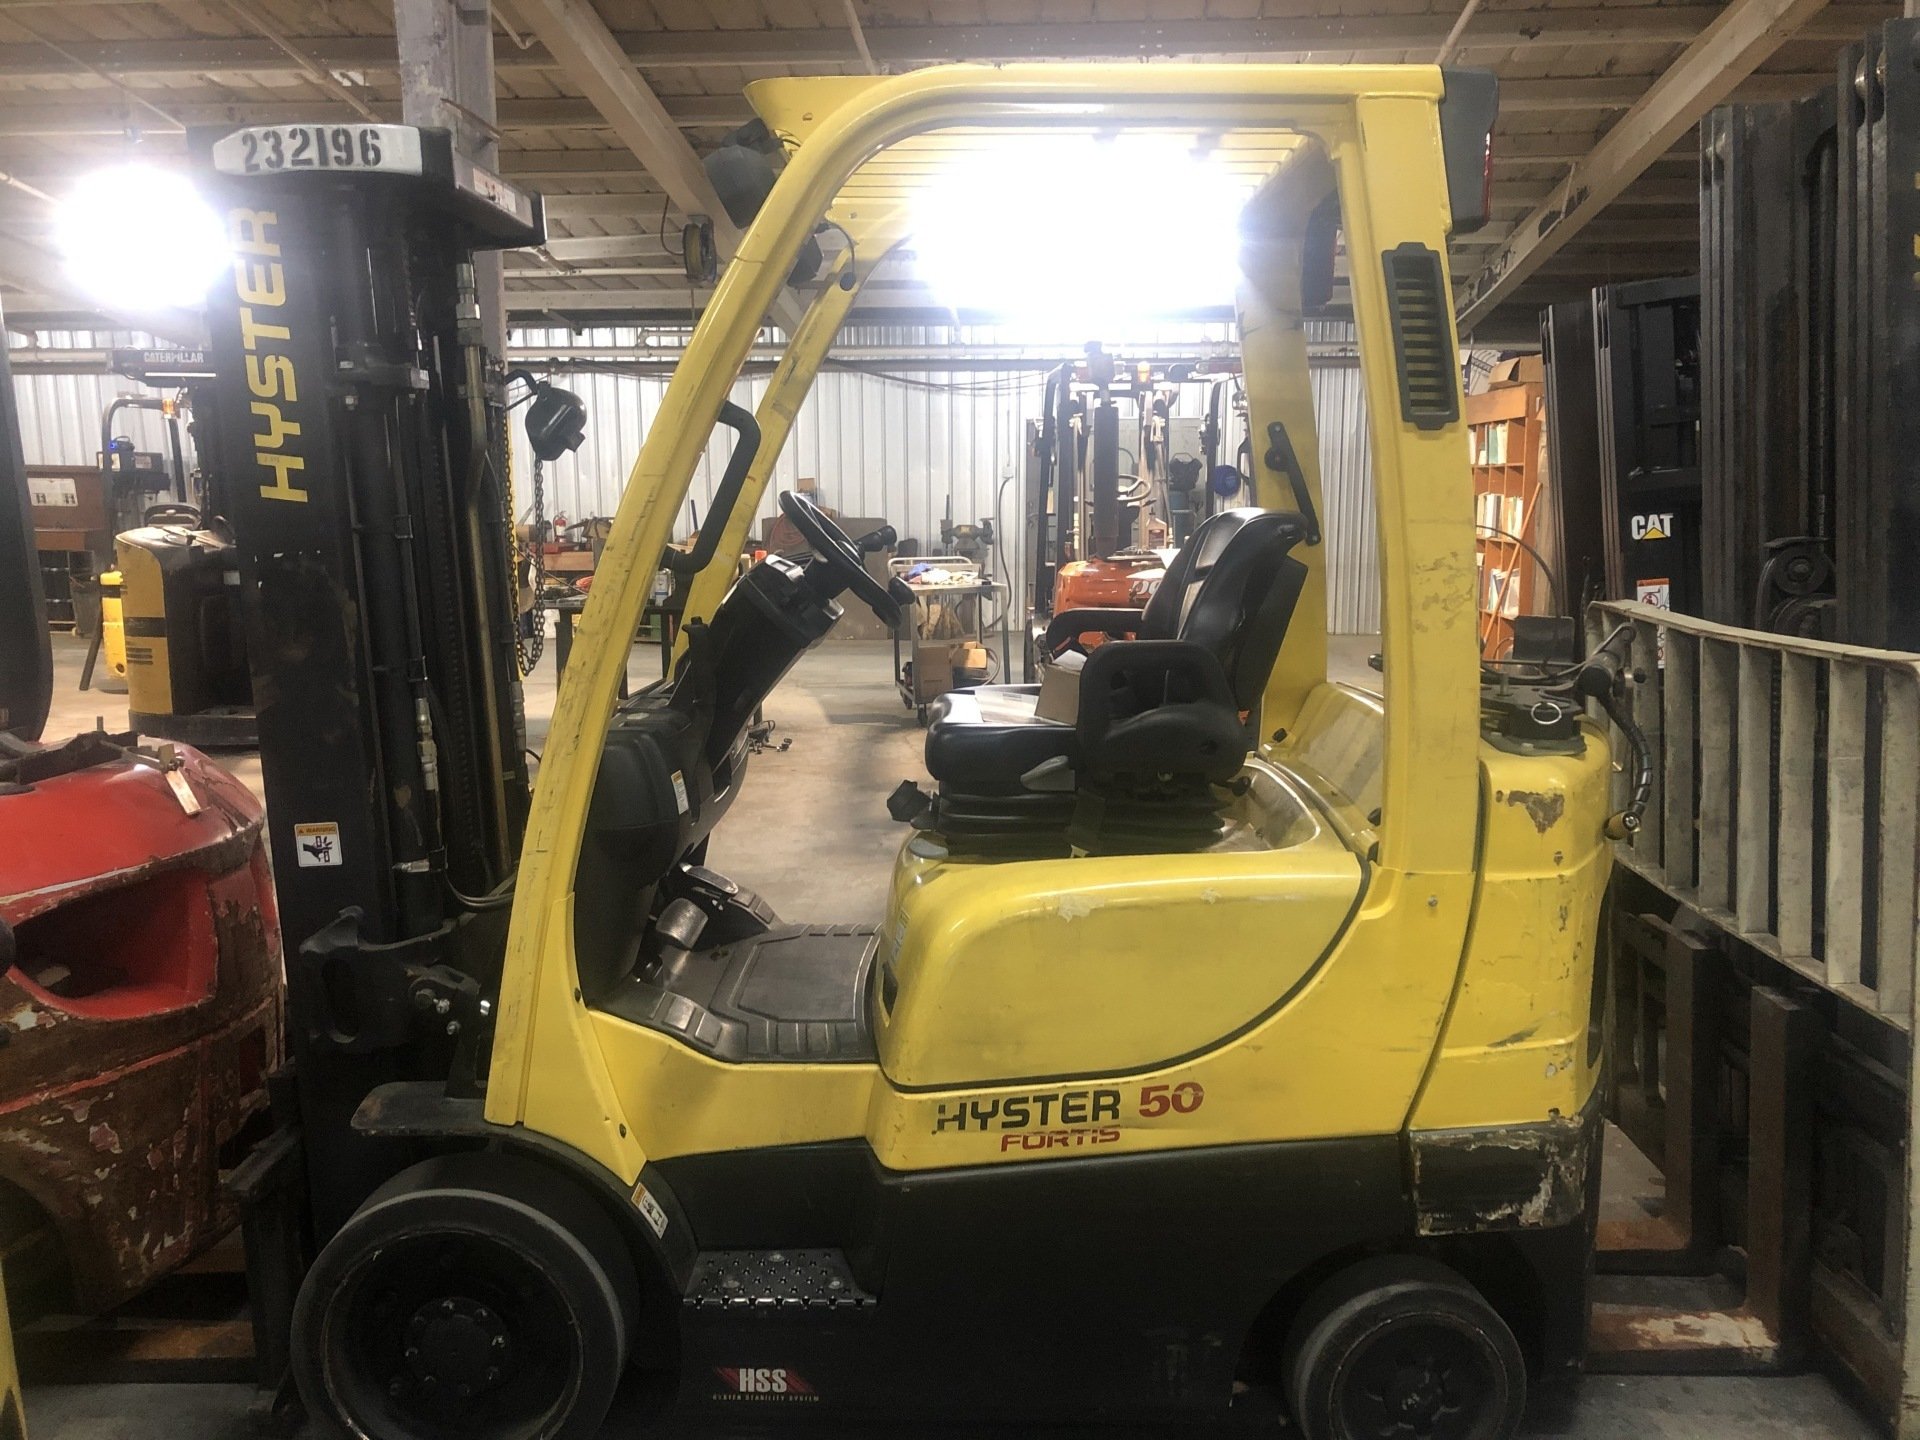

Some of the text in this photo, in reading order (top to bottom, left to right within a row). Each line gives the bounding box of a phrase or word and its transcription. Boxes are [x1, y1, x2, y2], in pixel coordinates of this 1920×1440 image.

[242, 127, 381, 173] 232196
[144, 351, 204, 363] CATERPILLAR
[228, 206, 308, 503] HYSTER
[1631, 513, 1674, 540] CAT
[936, 1082, 1205, 1132] HYSTER 50
[1001, 1124, 1121, 1152] FORTIS
[739, 1368, 788, 1393] HSS
